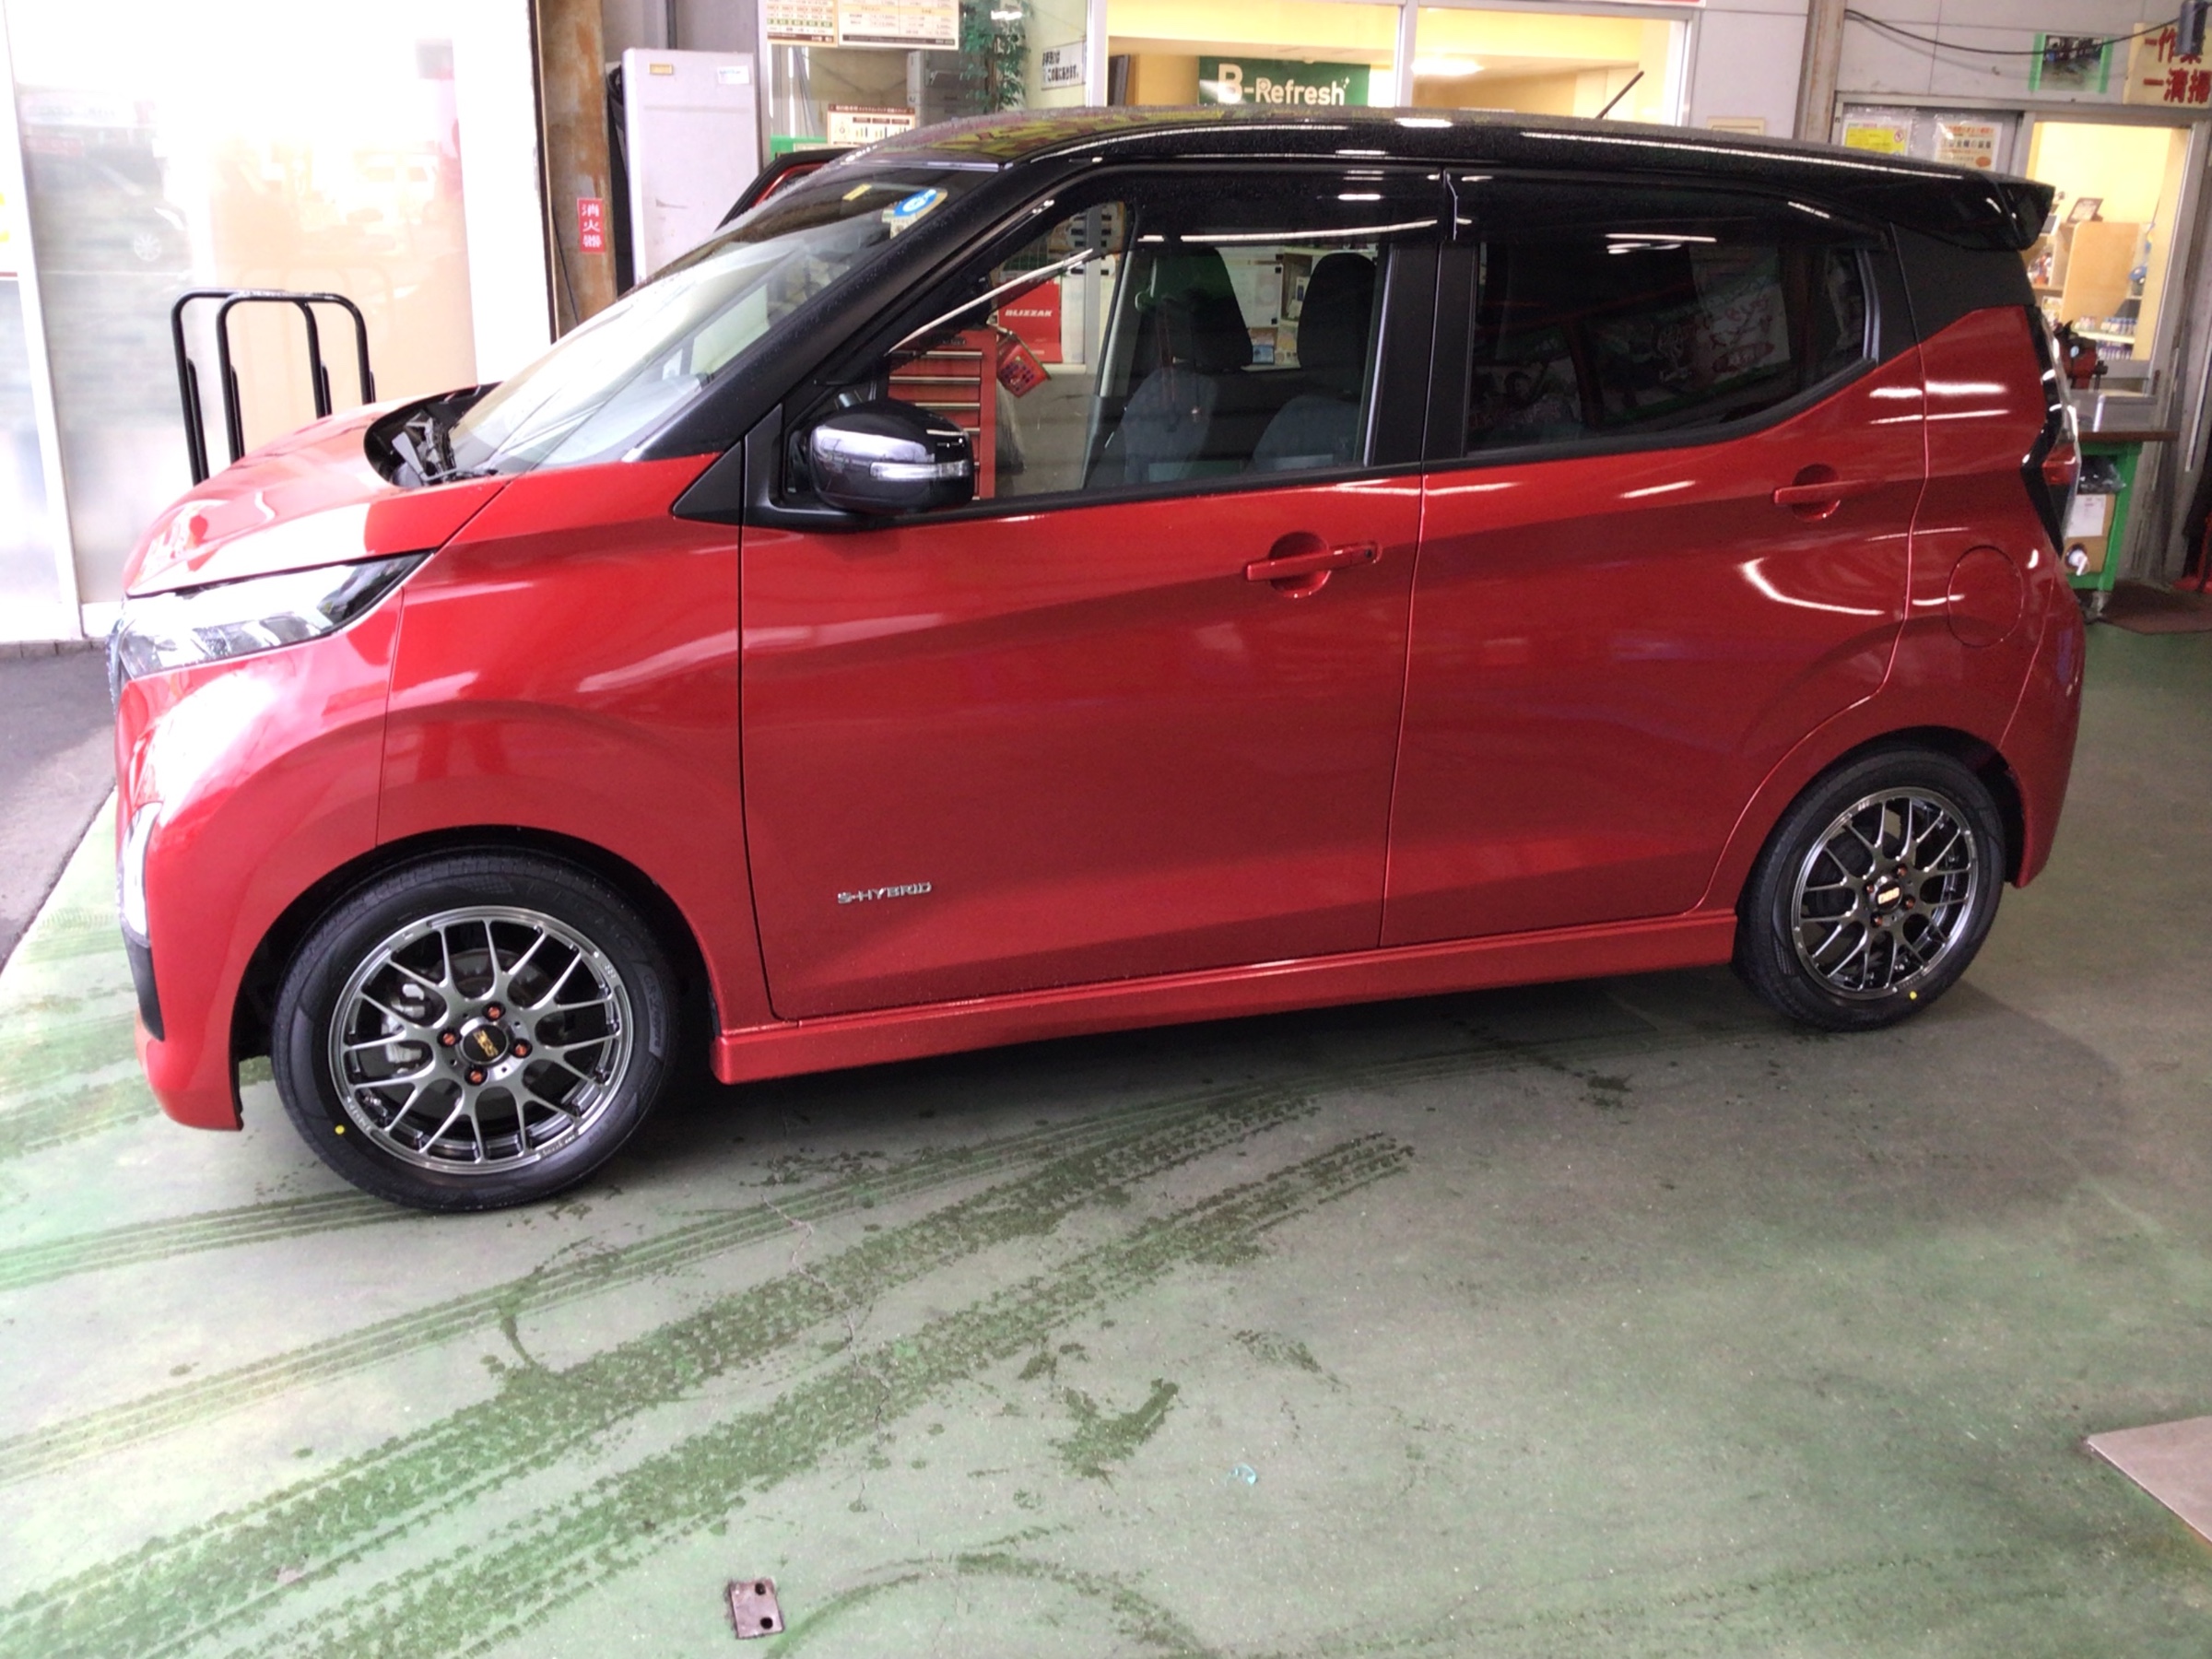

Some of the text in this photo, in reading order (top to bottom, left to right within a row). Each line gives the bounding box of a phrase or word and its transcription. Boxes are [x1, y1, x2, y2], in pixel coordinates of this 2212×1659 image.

[1218, 63, 1346, 106] B-Refresh
[1005, 309, 1053, 318] BLIZZAK
[837, 881, 932, 904] S-HYBRID
